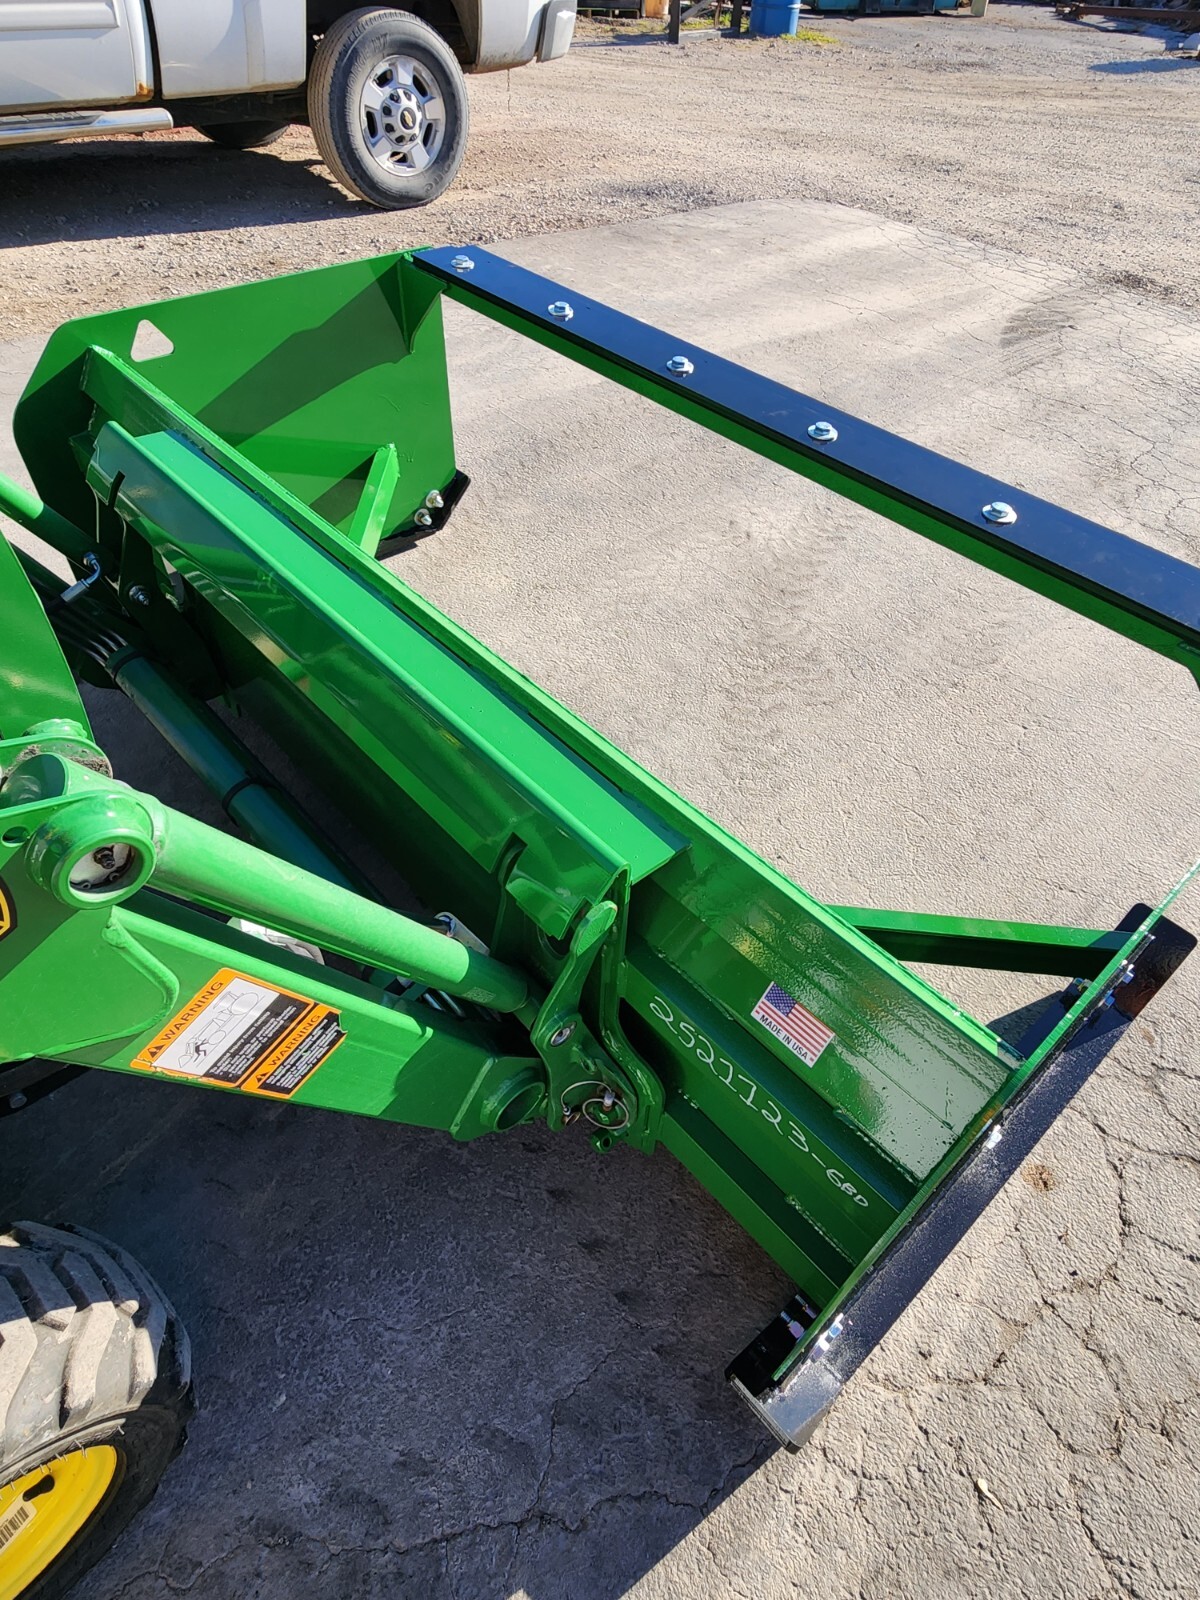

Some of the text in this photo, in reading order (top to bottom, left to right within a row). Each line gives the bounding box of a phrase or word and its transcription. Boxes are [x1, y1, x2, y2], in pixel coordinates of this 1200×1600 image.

[160, 981, 224, 1041] WARNING
[759, 1013, 808, 1061] MADE IN USA
[269, 1014, 321, 1066] WARNING
